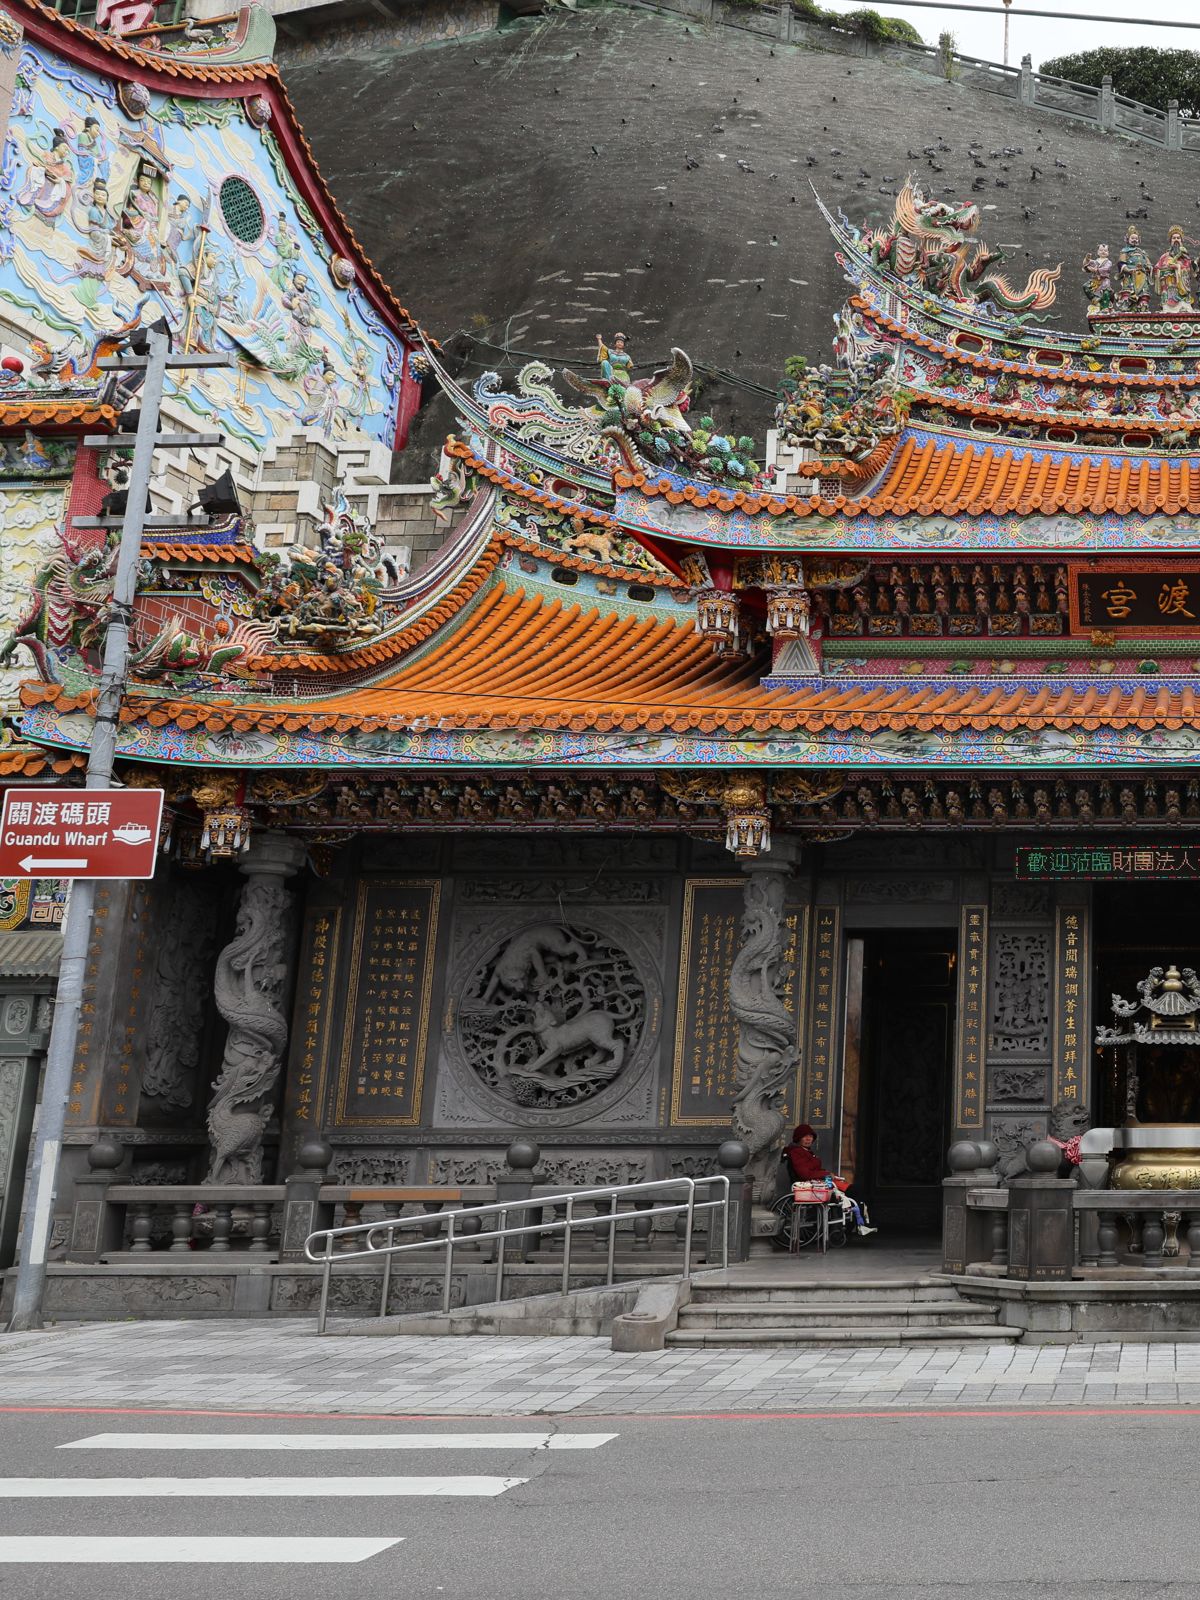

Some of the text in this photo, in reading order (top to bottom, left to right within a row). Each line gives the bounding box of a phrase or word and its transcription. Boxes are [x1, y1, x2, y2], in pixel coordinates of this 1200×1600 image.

[7, 802, 112, 826] 關渡碼頭
[5, 831, 108, 846] Guandu Wharf
